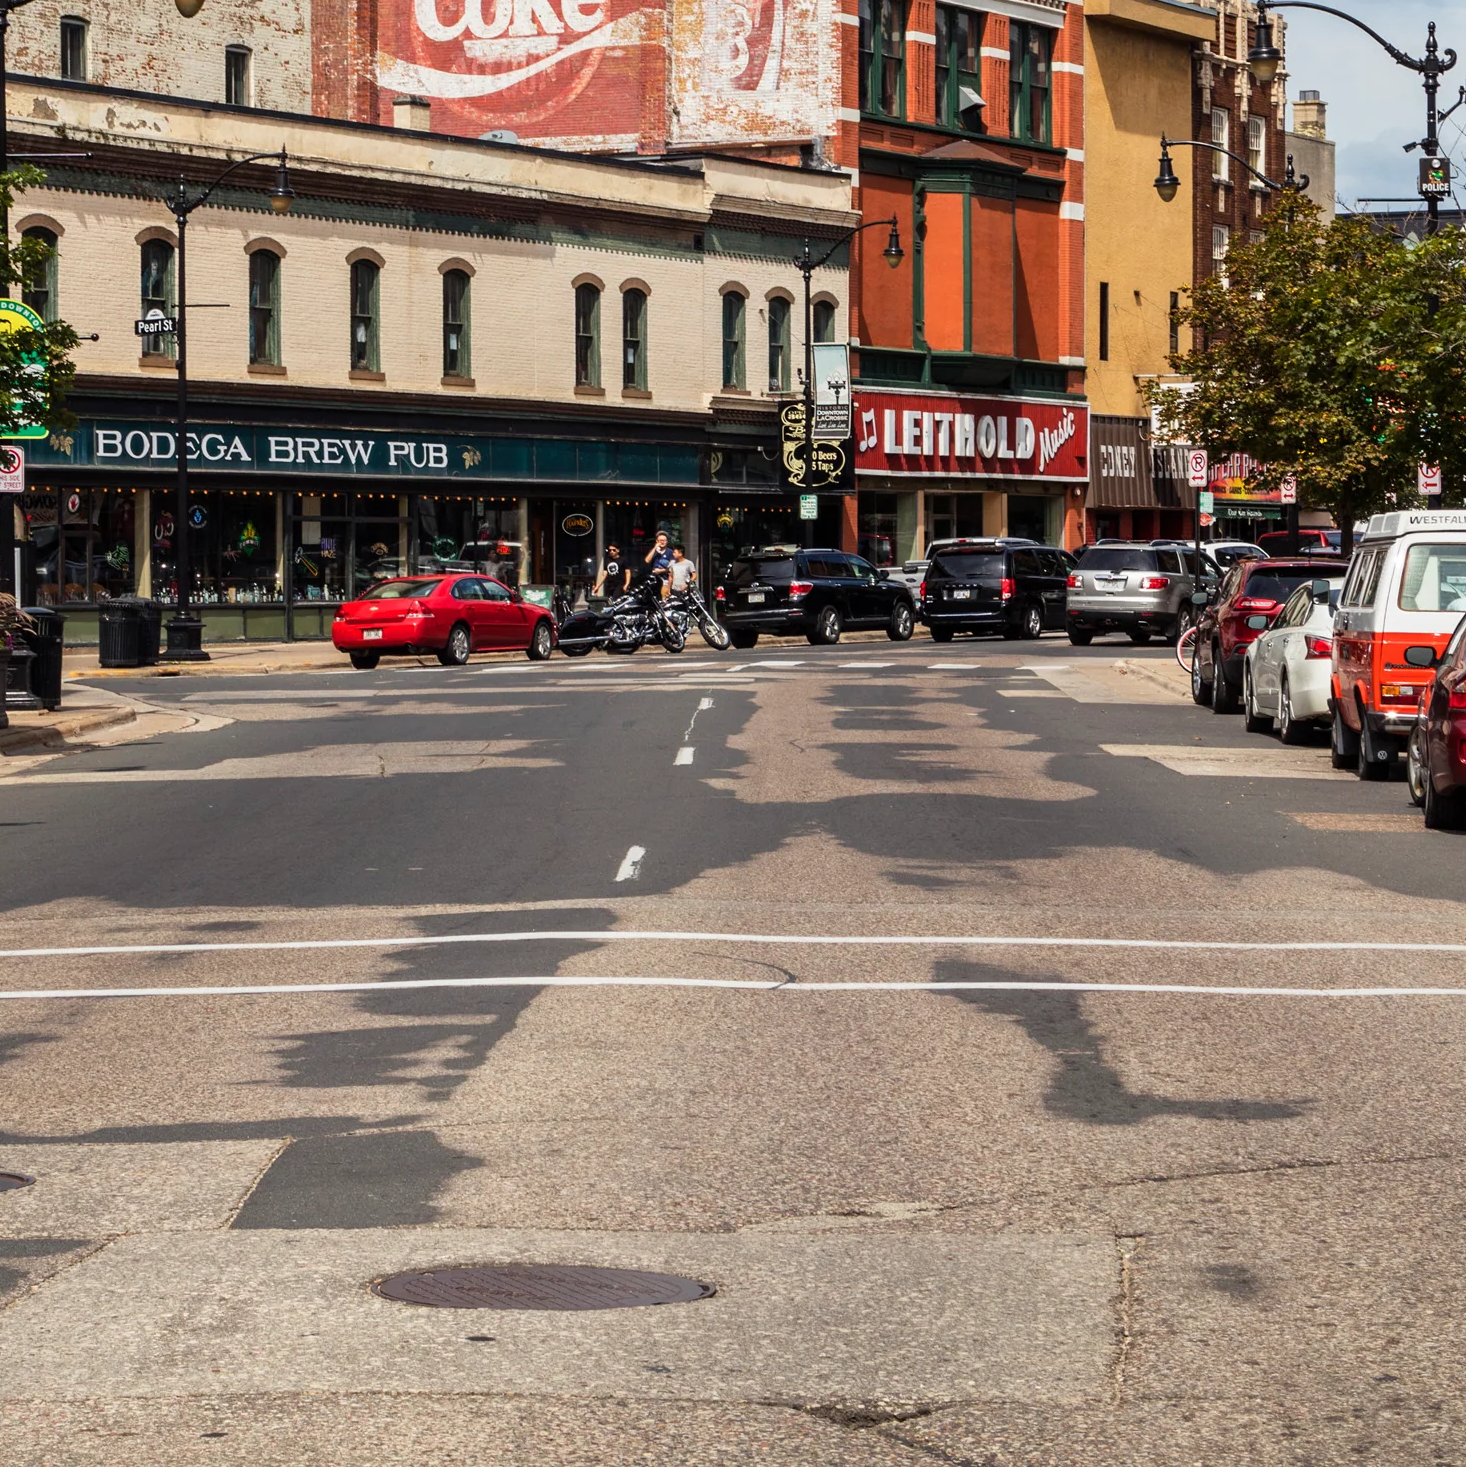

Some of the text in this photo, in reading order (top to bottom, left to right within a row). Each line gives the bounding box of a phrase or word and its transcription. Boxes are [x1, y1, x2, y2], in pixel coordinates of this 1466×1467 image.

[1422, 183, 1450, 192] POLICE
[138, 319, 173, 334] Pearl St
[884, 407, 1076, 472] LEITHOLD Music
[95, 429, 448, 469] BODEGA BREW PUB
[818, 451, 837, 460] Beers
[818, 461, 834, 473] Taps
[1100, 445, 1136, 478] CONEY
